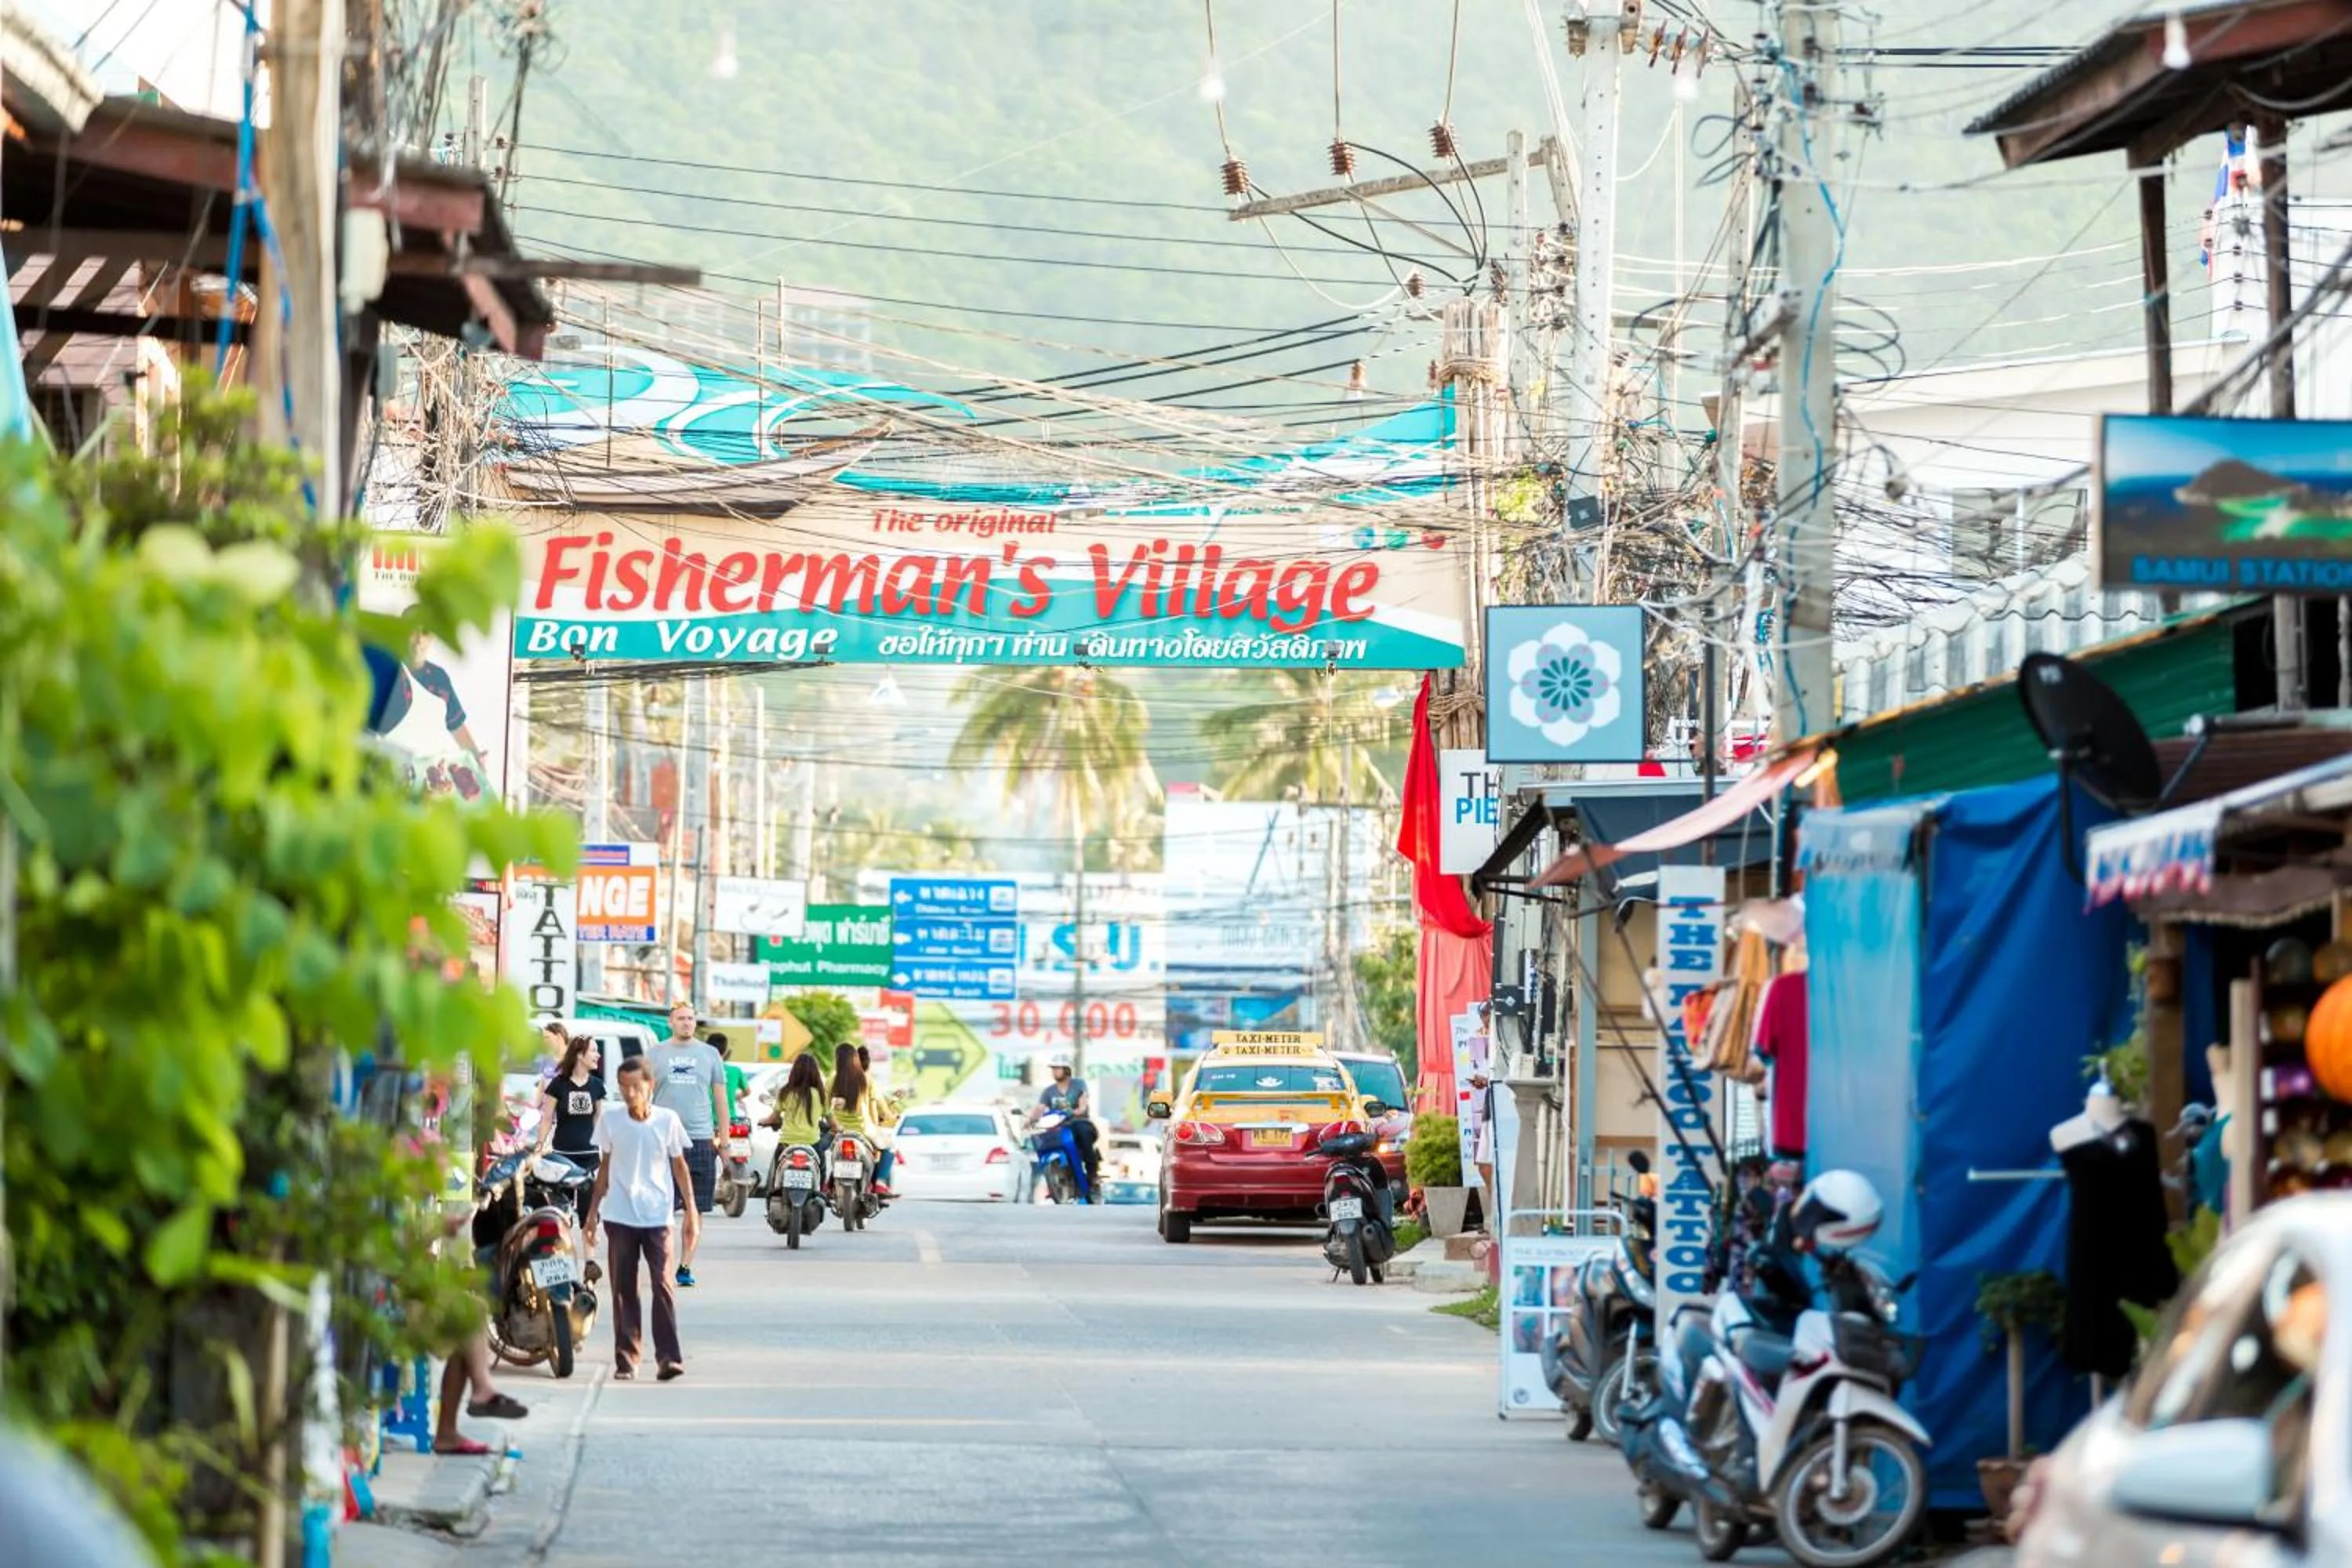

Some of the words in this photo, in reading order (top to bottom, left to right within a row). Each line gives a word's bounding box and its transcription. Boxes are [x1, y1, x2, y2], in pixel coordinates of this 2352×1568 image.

[872, 509, 924, 532] The
[934, 508, 1057, 538] original
[535, 531, 1055, 618] Fisherman's
[1088, 538, 1381, 633] Village
[2238, 556, 2352, 587] STATIO
[528, 622, 619, 652] Bon
[657, 620, 838, 659] Voyage
[1079, 629, 1367, 660] ดินทางโดยสวัสดิภาพ
[1460, 772, 1497, 798] TH
[1457, 797, 1499, 823] PIE
[528, 882, 568, 1019] TATTO
[989, 1002, 1139, 1043] 30,000
[1235, 1033, 1301, 1044] TAXI-METER
[1235, 1045, 1301, 1055] TAXI-METER
[1664, 1142, 1714, 1295] TATTOO
